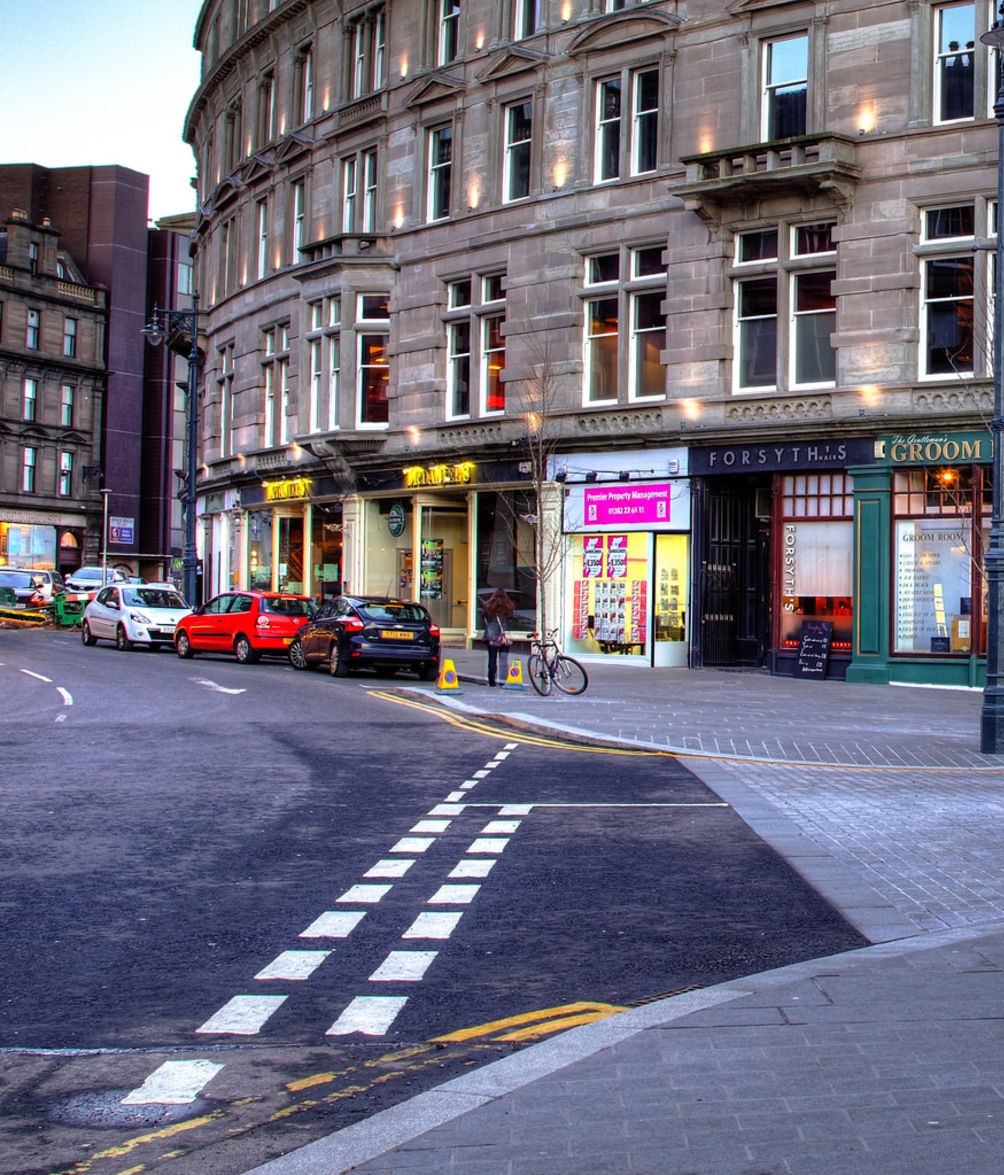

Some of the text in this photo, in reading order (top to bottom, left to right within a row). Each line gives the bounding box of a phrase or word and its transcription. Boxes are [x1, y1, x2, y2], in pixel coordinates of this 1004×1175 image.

[709, 445, 847, 467] FORSYTH'S
[890, 440, 982, 462] GROOM
[587, 490, 668, 501] Premier Property Management
[903, 533, 935, 542] GROOM
[785, 525, 795, 611] FORSYTH'S
